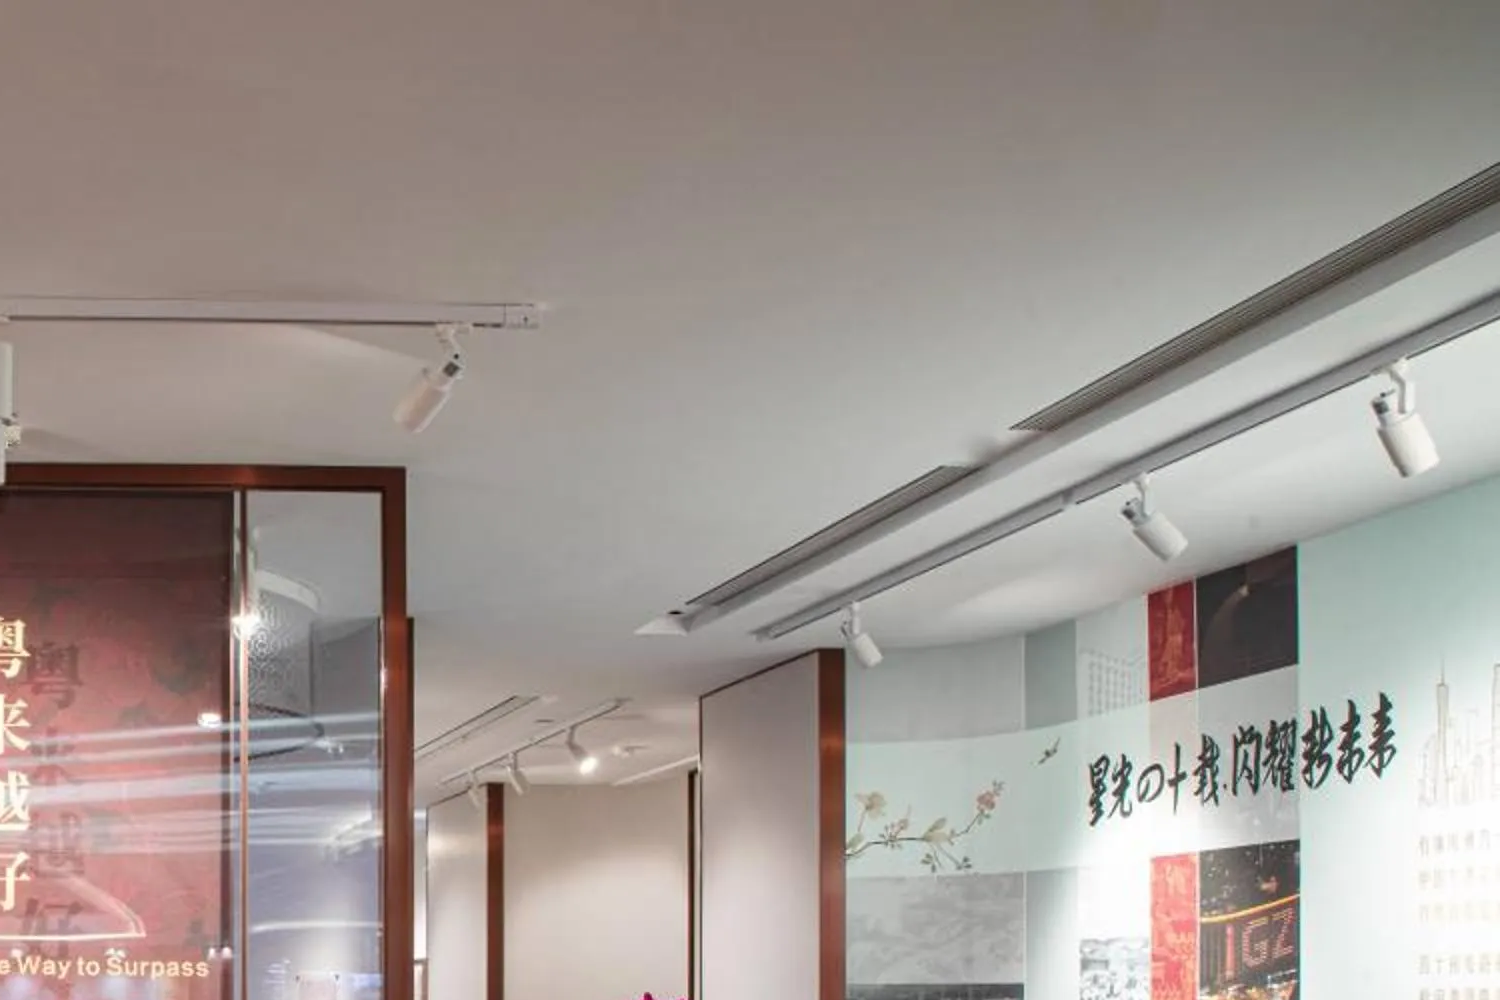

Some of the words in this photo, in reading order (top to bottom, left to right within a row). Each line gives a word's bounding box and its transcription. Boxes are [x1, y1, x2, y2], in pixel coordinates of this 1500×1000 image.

[15, 955, 71, 979] Way
[77, 955, 100, 975] to
[106, 955, 209, 979] Surpass
